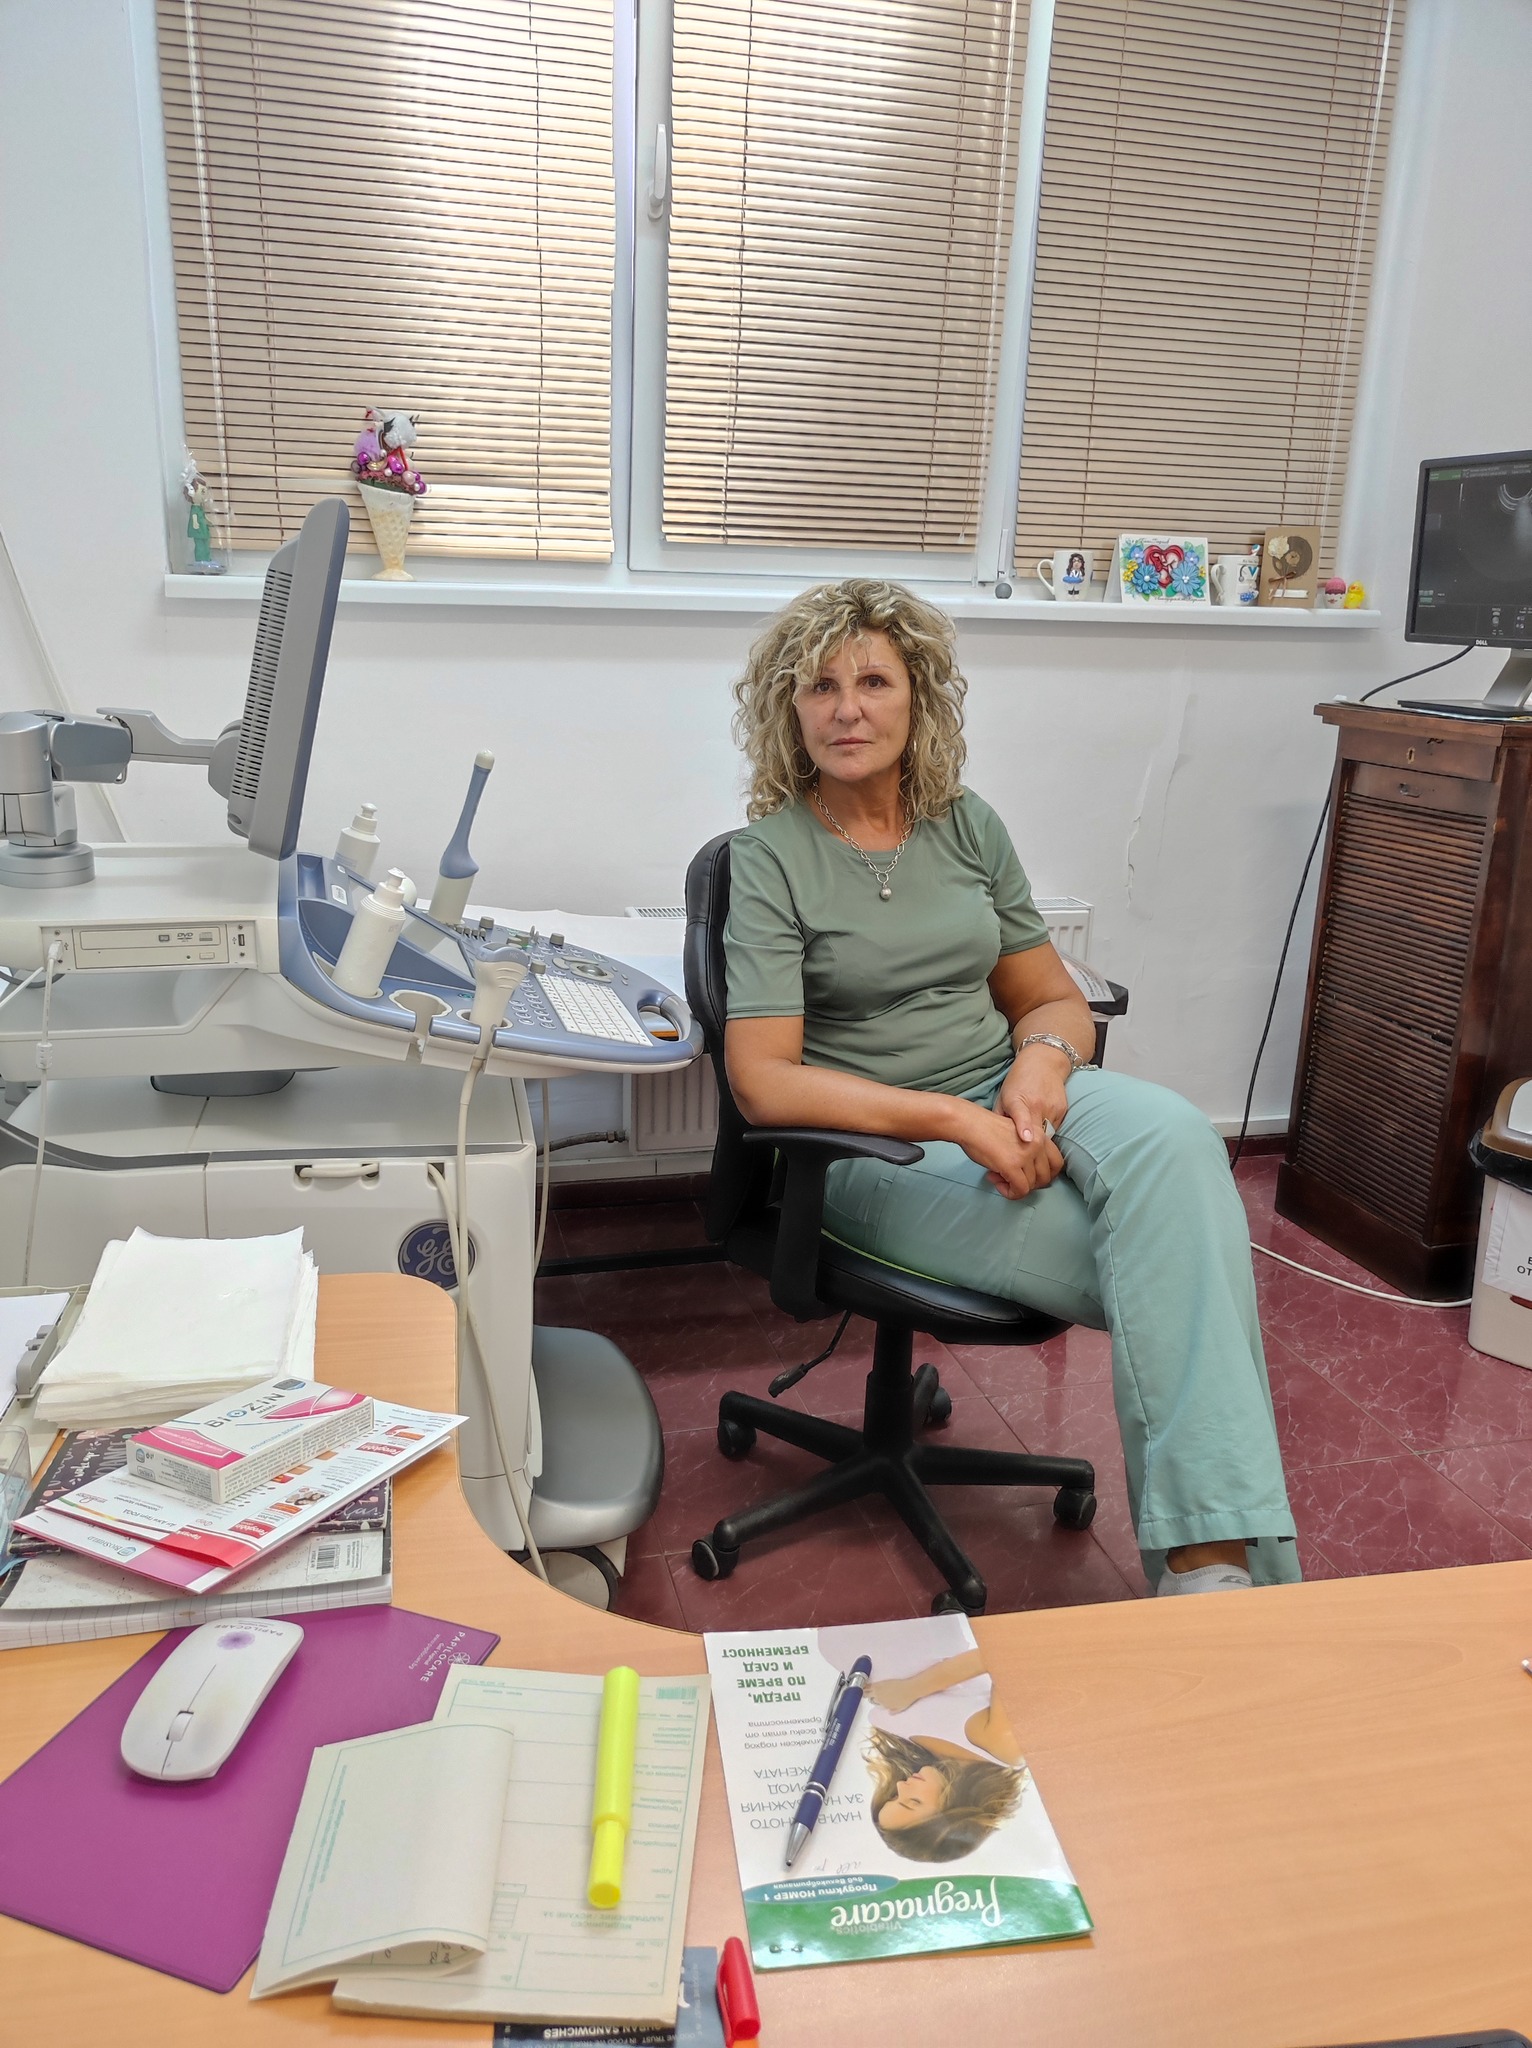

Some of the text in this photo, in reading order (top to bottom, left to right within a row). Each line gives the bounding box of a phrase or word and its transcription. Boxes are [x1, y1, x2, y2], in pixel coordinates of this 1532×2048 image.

[420, 1631, 466, 1682] PAPILOCARE
[722, 1645, 810, 1658] БРЕМЕННОСТ
[742, 1661, 793, 1673] И СЛЕД
[737, 1676, 806, 1688] ПО ВРЕМЕ
[748, 1691, 802, 1704] ПРЕДИ,
[744, 1741, 778, 1750] подход
[845, 1793, 864, 1804] ЗА
[764, 1882, 878, 1901] Продукти НОМЕР 1
[830, 1876, 1005, 1928] Pregnacare
[543, 2026, 620, 2039] SANDWICHES
